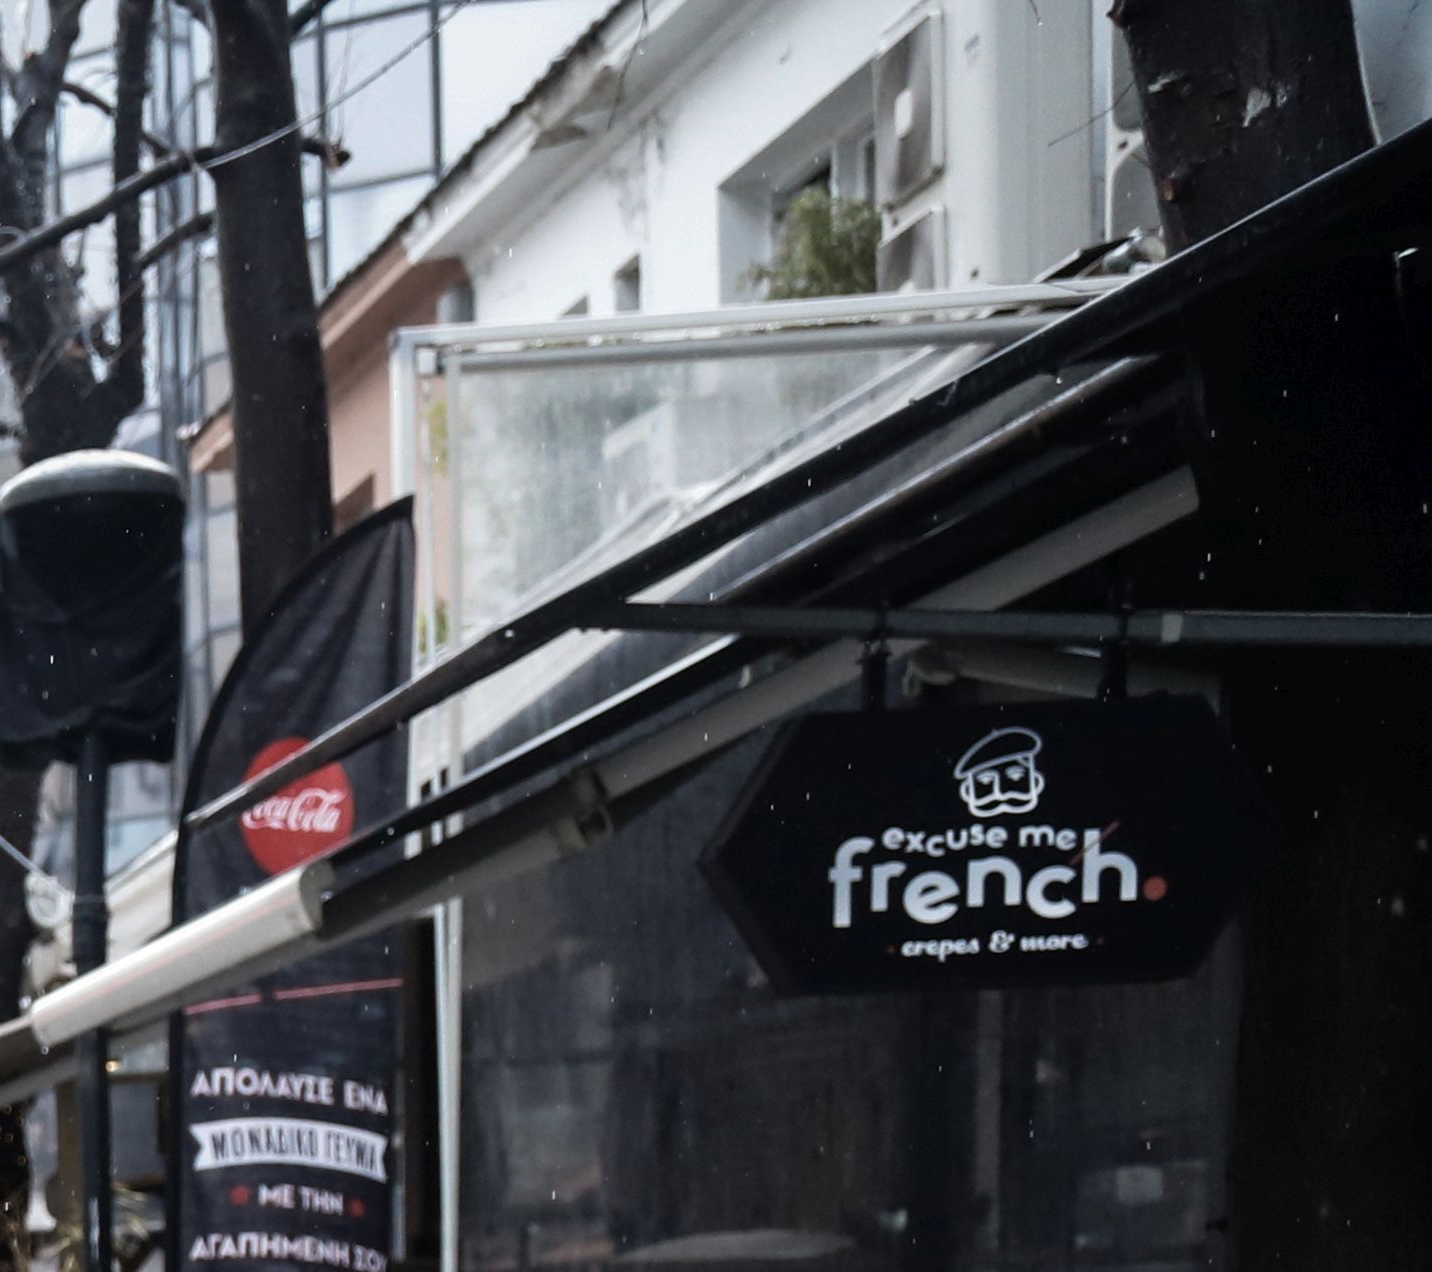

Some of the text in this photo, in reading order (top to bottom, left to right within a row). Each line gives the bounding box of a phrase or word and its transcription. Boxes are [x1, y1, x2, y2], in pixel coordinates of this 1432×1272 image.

[882, 824, 1077, 857] excuse me
[900, 930, 1089, 962] crepes & more
[190, 1067, 389, 1116] ΑΠΟΛΑΥΣΕ ΕΝΑ
[258, 1184, 344, 1216] ΜΕ ΤΗΝ
[189, 1231, 351, 1271] ΑΓΑΠΗΜΕΝΗ
